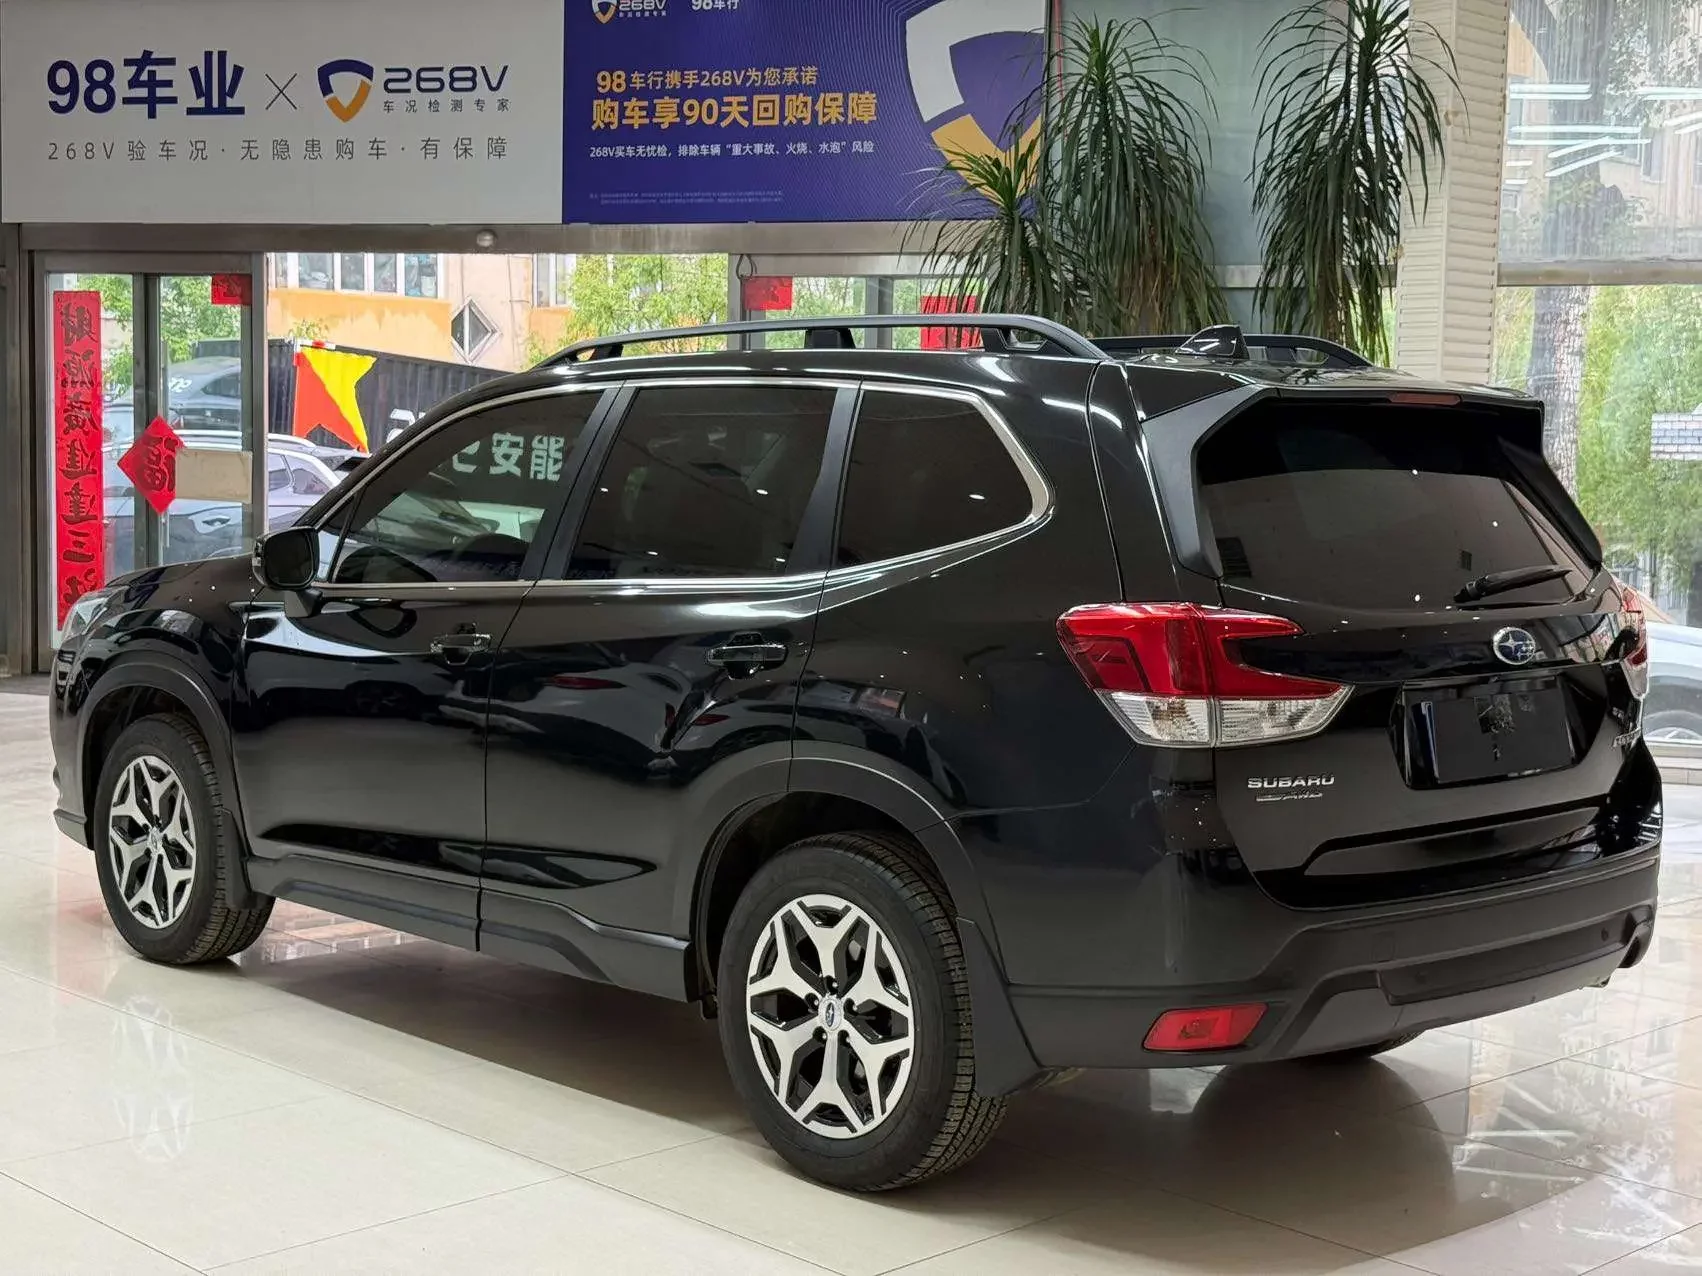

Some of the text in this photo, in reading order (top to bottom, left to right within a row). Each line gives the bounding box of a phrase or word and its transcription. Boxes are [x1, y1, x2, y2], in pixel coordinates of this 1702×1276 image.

[47, 49, 246, 120] 98车业
[383, 65, 509, 95] 268V
[383, 98, 511, 114] 车况检测专家
[591, 90, 878, 131] 购车享90天回购保障
[489, 432, 565, 483] 安能
[1247, 775, 1335, 789] SUBARU
